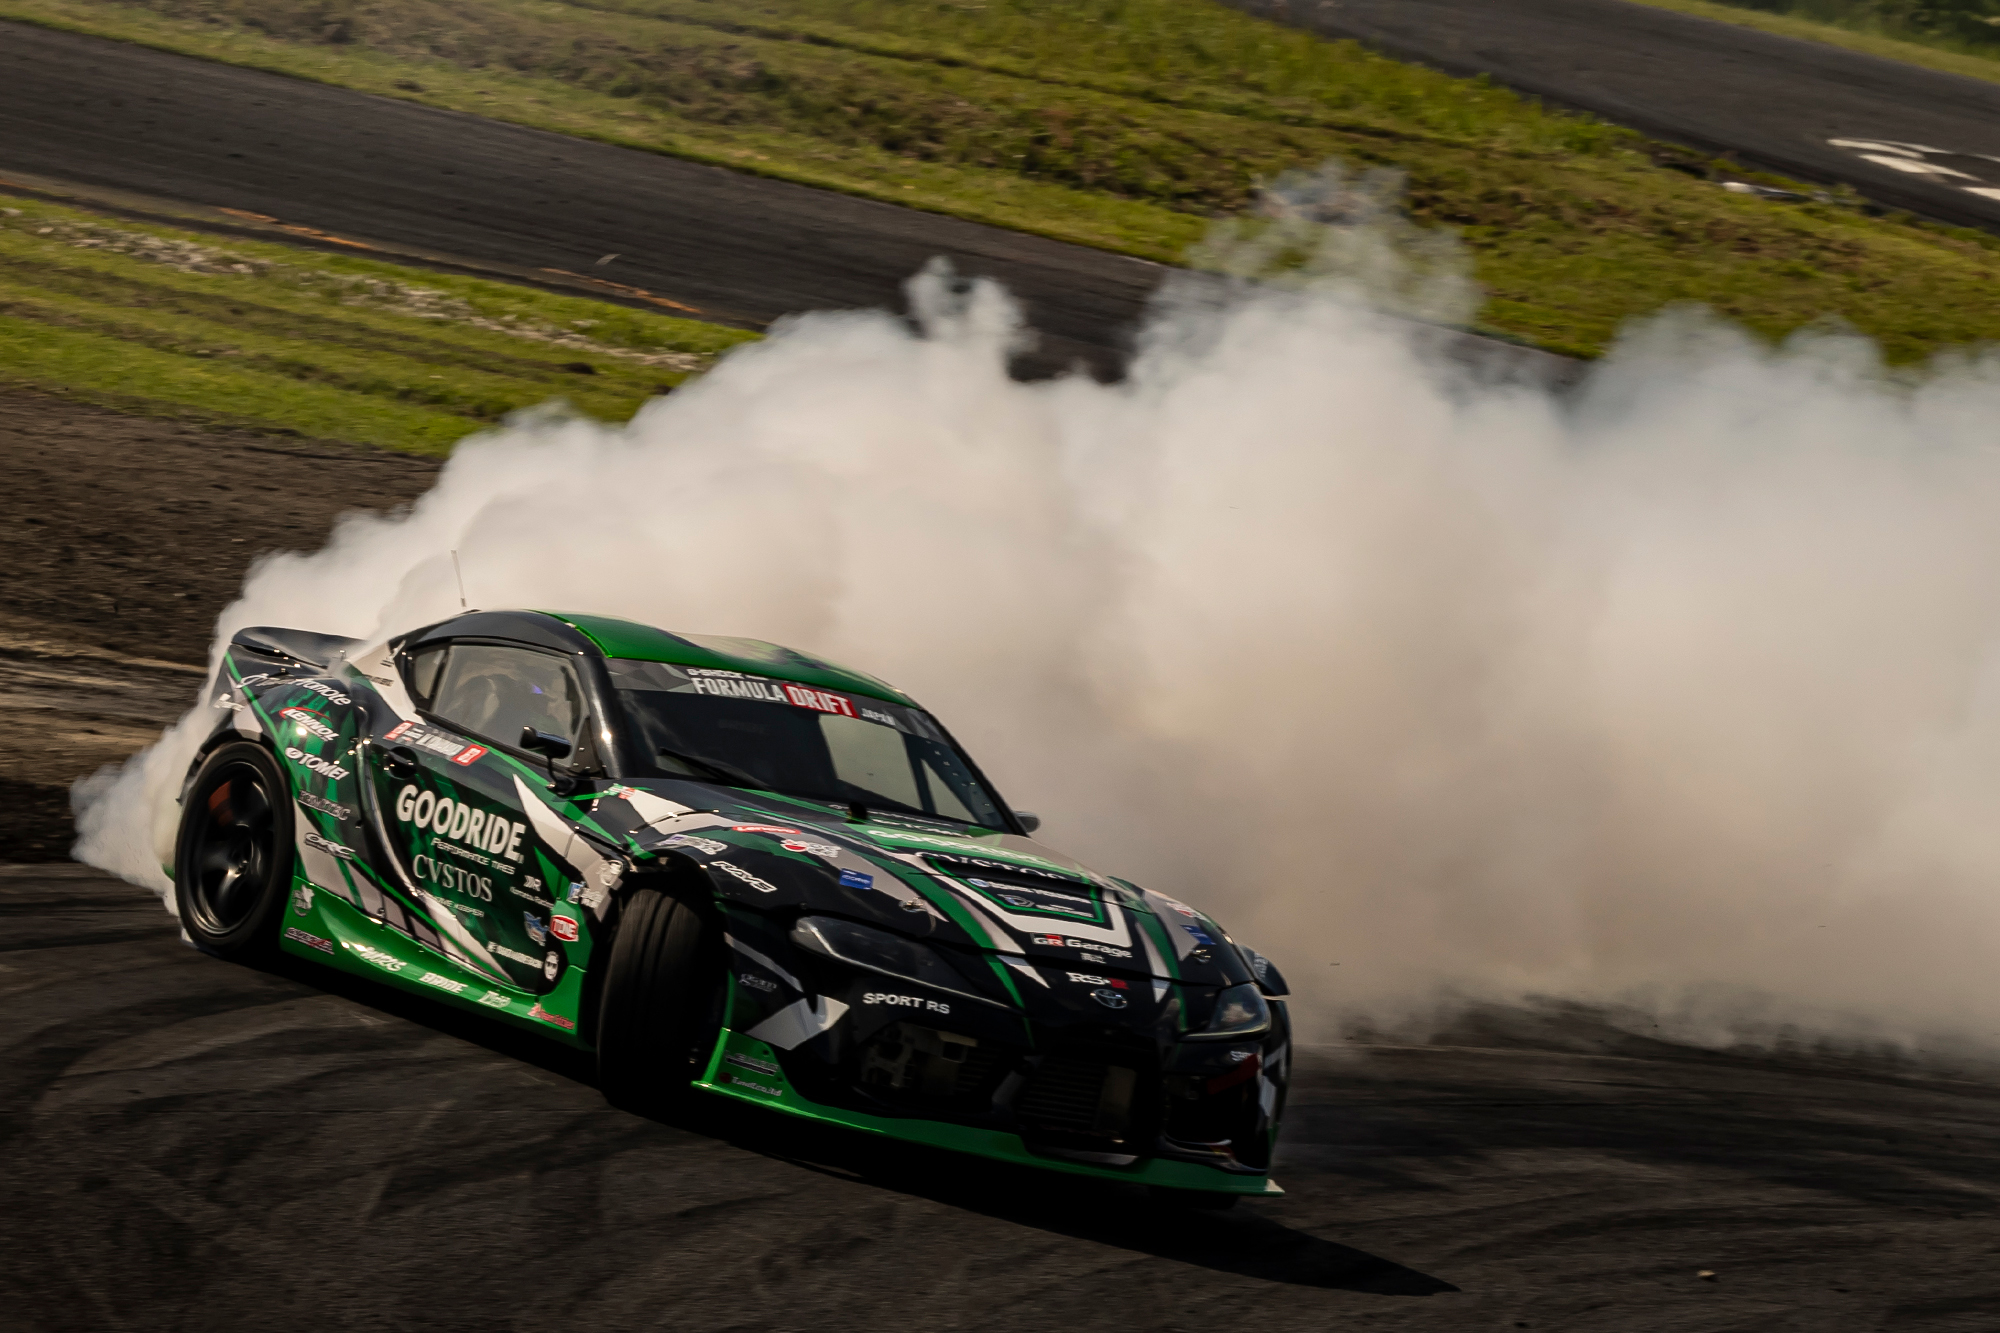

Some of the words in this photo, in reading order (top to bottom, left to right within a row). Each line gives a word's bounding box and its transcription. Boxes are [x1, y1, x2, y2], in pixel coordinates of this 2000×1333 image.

[690, 677, 789, 702] FORMULA
[785, 685, 853, 716] DRIFT
[298, 753, 350, 781] TOMEI
[396, 784, 526, 863] GOODRIDE
[412, 854, 493, 903] CVSTOS
[1032, 937, 1065, 947] GR
[1065, 939, 1133, 958] Garage
[863, 993, 924, 1008] SPORT
[926, 1000, 950, 1014] RS
